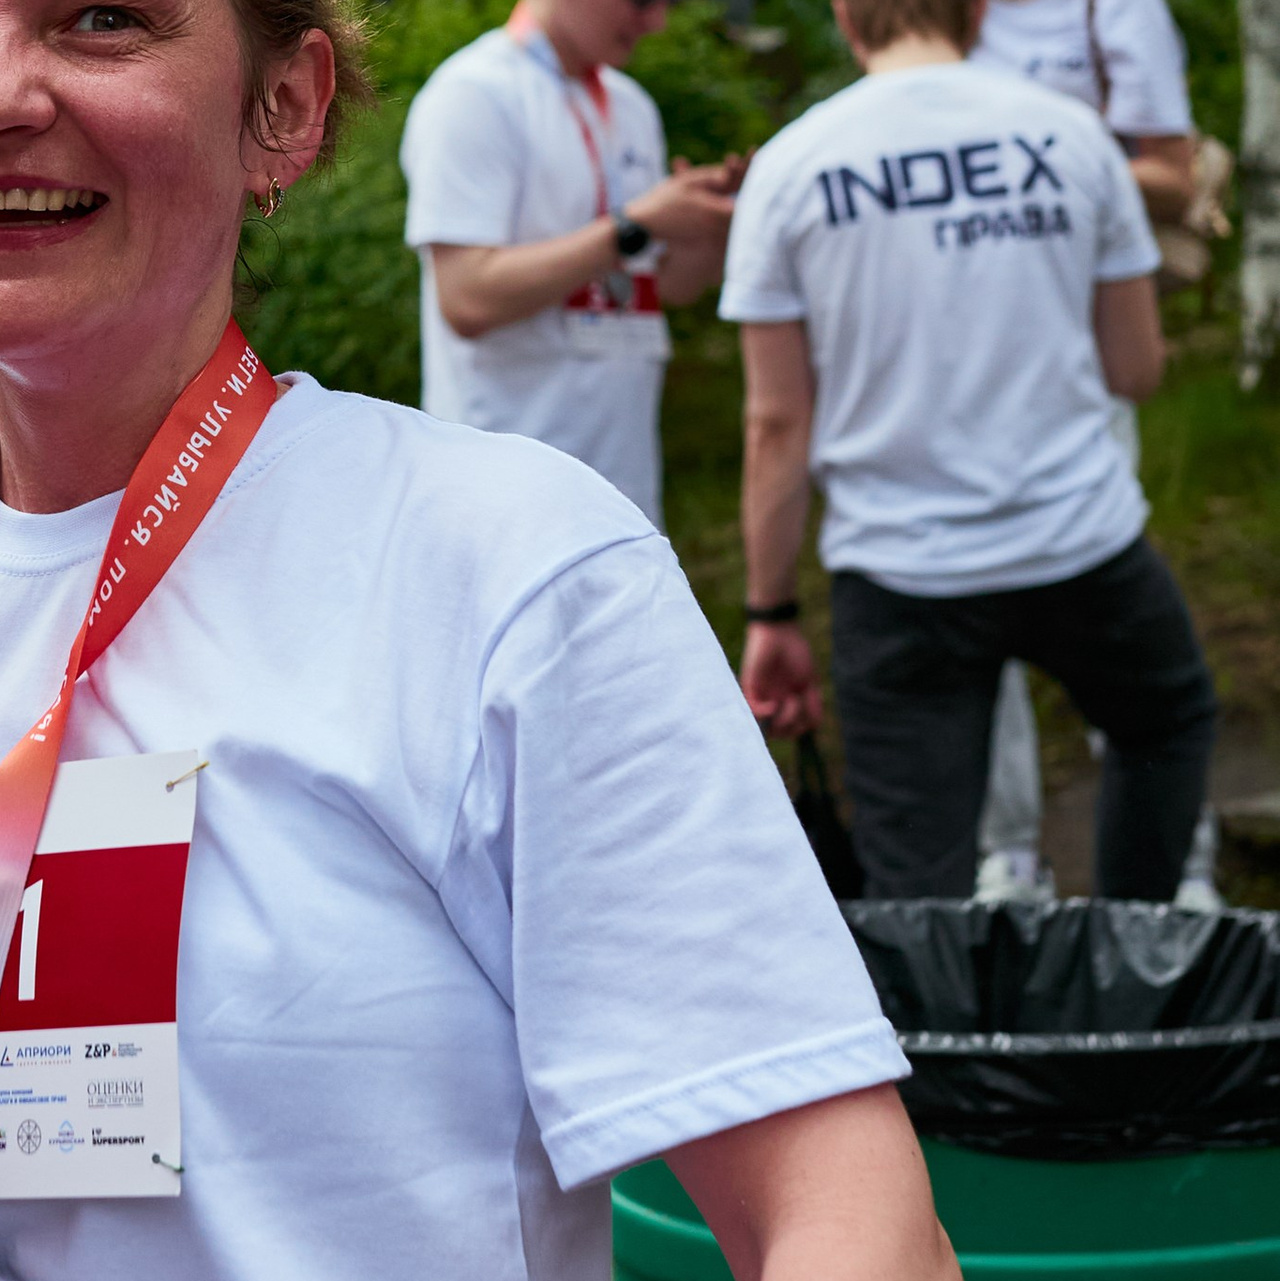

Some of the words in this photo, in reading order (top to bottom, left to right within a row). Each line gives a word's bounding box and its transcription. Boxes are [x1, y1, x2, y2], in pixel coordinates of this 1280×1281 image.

[817, 133, 1064, 226] INDEX
[934, 204, 1074, 251] ПРАВА
[221, 345, 259, 397] БЕГИ.
[124, 399, 232, 547] УЛЫБАЙСЯ.
[16, 1045, 71, 1058] АПРИОРИ
[84, 1043, 111, 1059] Z&P
[87, 1080, 144, 1096] ОЦЕНКИ
[92, 1136, 145, 1146] SUPERSPORT
